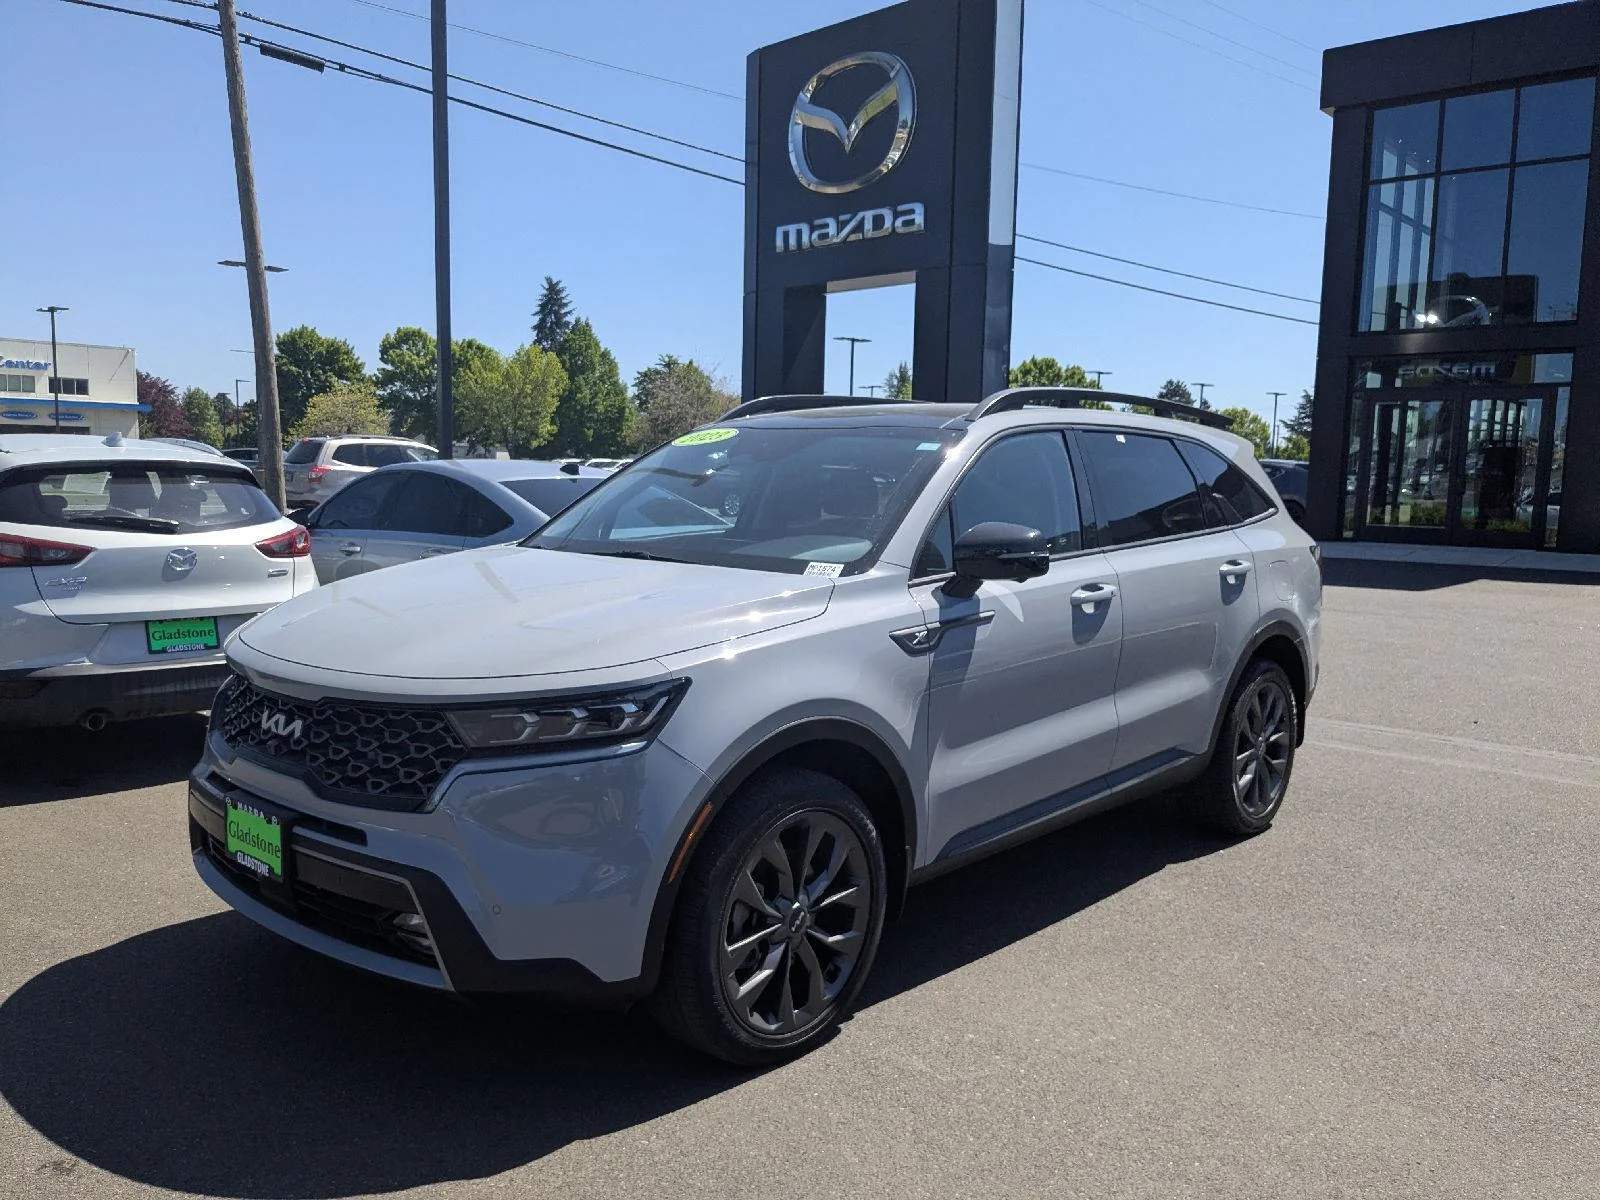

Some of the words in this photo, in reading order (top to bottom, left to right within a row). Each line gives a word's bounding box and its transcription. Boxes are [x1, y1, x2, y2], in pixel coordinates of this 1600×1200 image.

[152, 628, 214, 641] Gladstone
[166, 643, 205, 653] GLADSTONE
[261, 705, 303, 739] KIA
[237, 800, 265, 819] MAZDA
[228, 820, 281, 859] Gladstone
[236, 851, 270, 877] GLADSTONE
